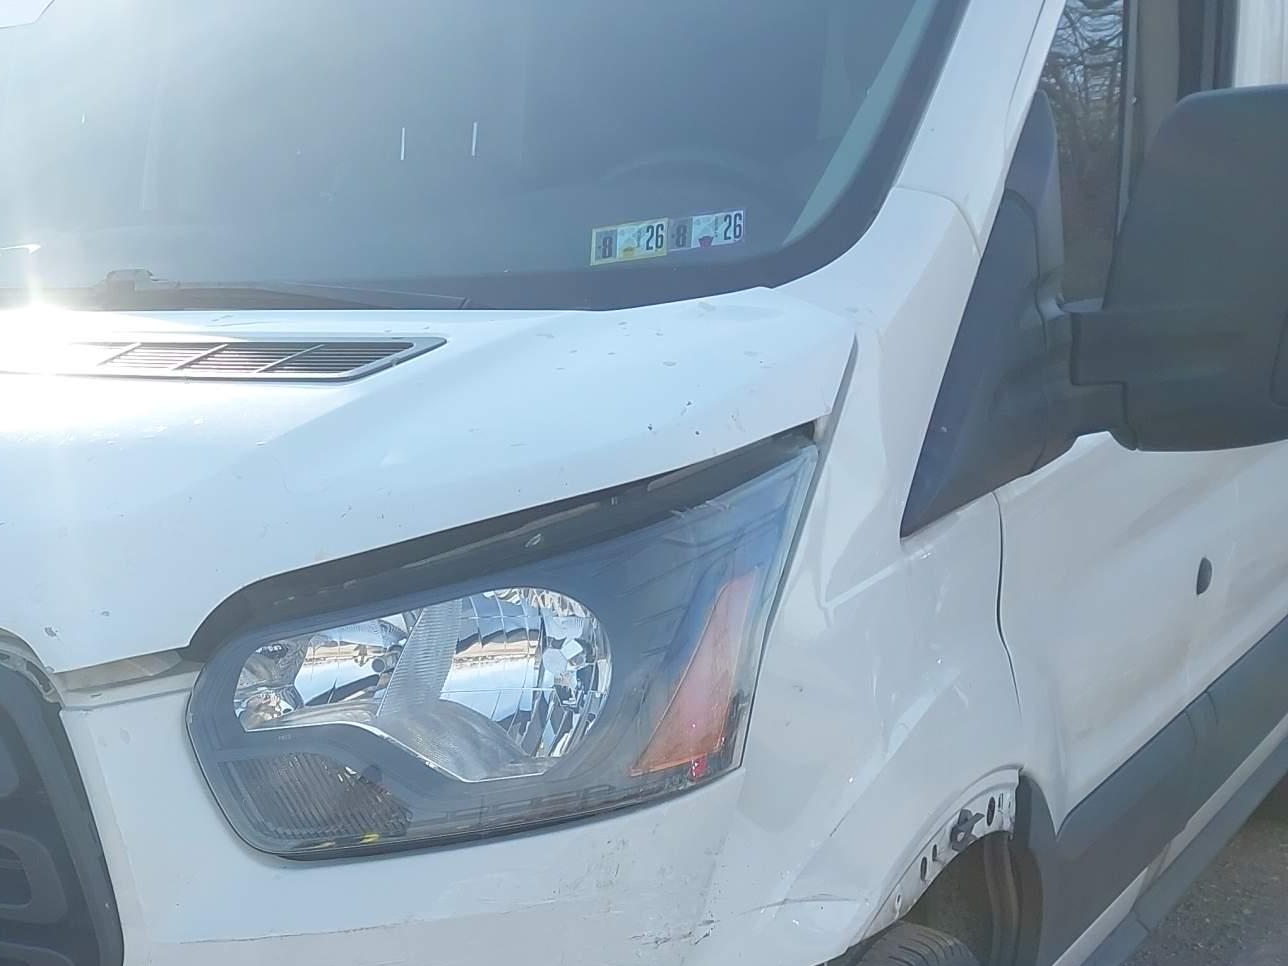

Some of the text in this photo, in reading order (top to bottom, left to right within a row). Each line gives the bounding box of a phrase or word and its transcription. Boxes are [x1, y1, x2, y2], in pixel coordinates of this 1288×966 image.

[645, 223, 665, 251] 26
[675, 212, 743, 247] 8 26
